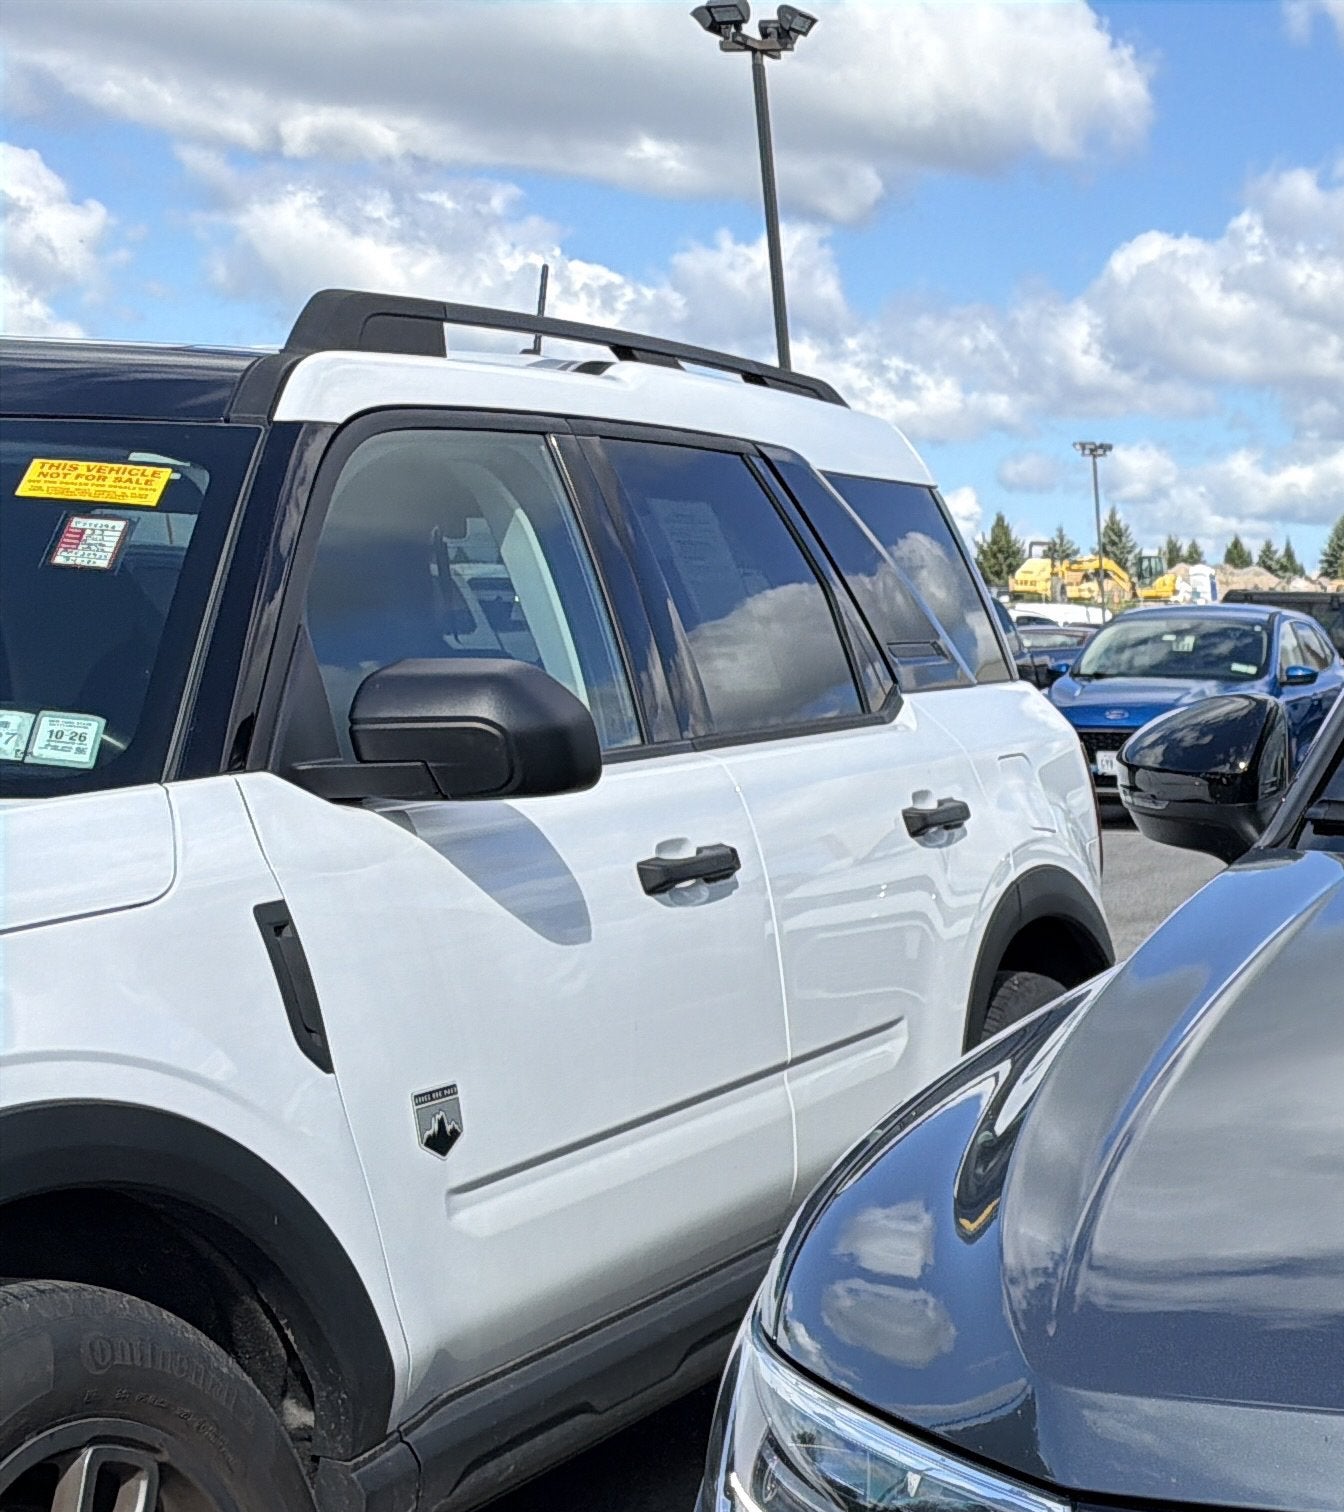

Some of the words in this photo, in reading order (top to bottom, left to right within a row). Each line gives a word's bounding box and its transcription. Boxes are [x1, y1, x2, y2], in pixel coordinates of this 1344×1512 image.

[39, 462, 79, 474] THIS
[86, 464, 163, 480] VEHICLE
[37, 472, 71, 481] NOT
[76, 473, 106, 483] FOR
[112, 476, 155, 487] SALE
[47, 729, 88, 743] 10-26
